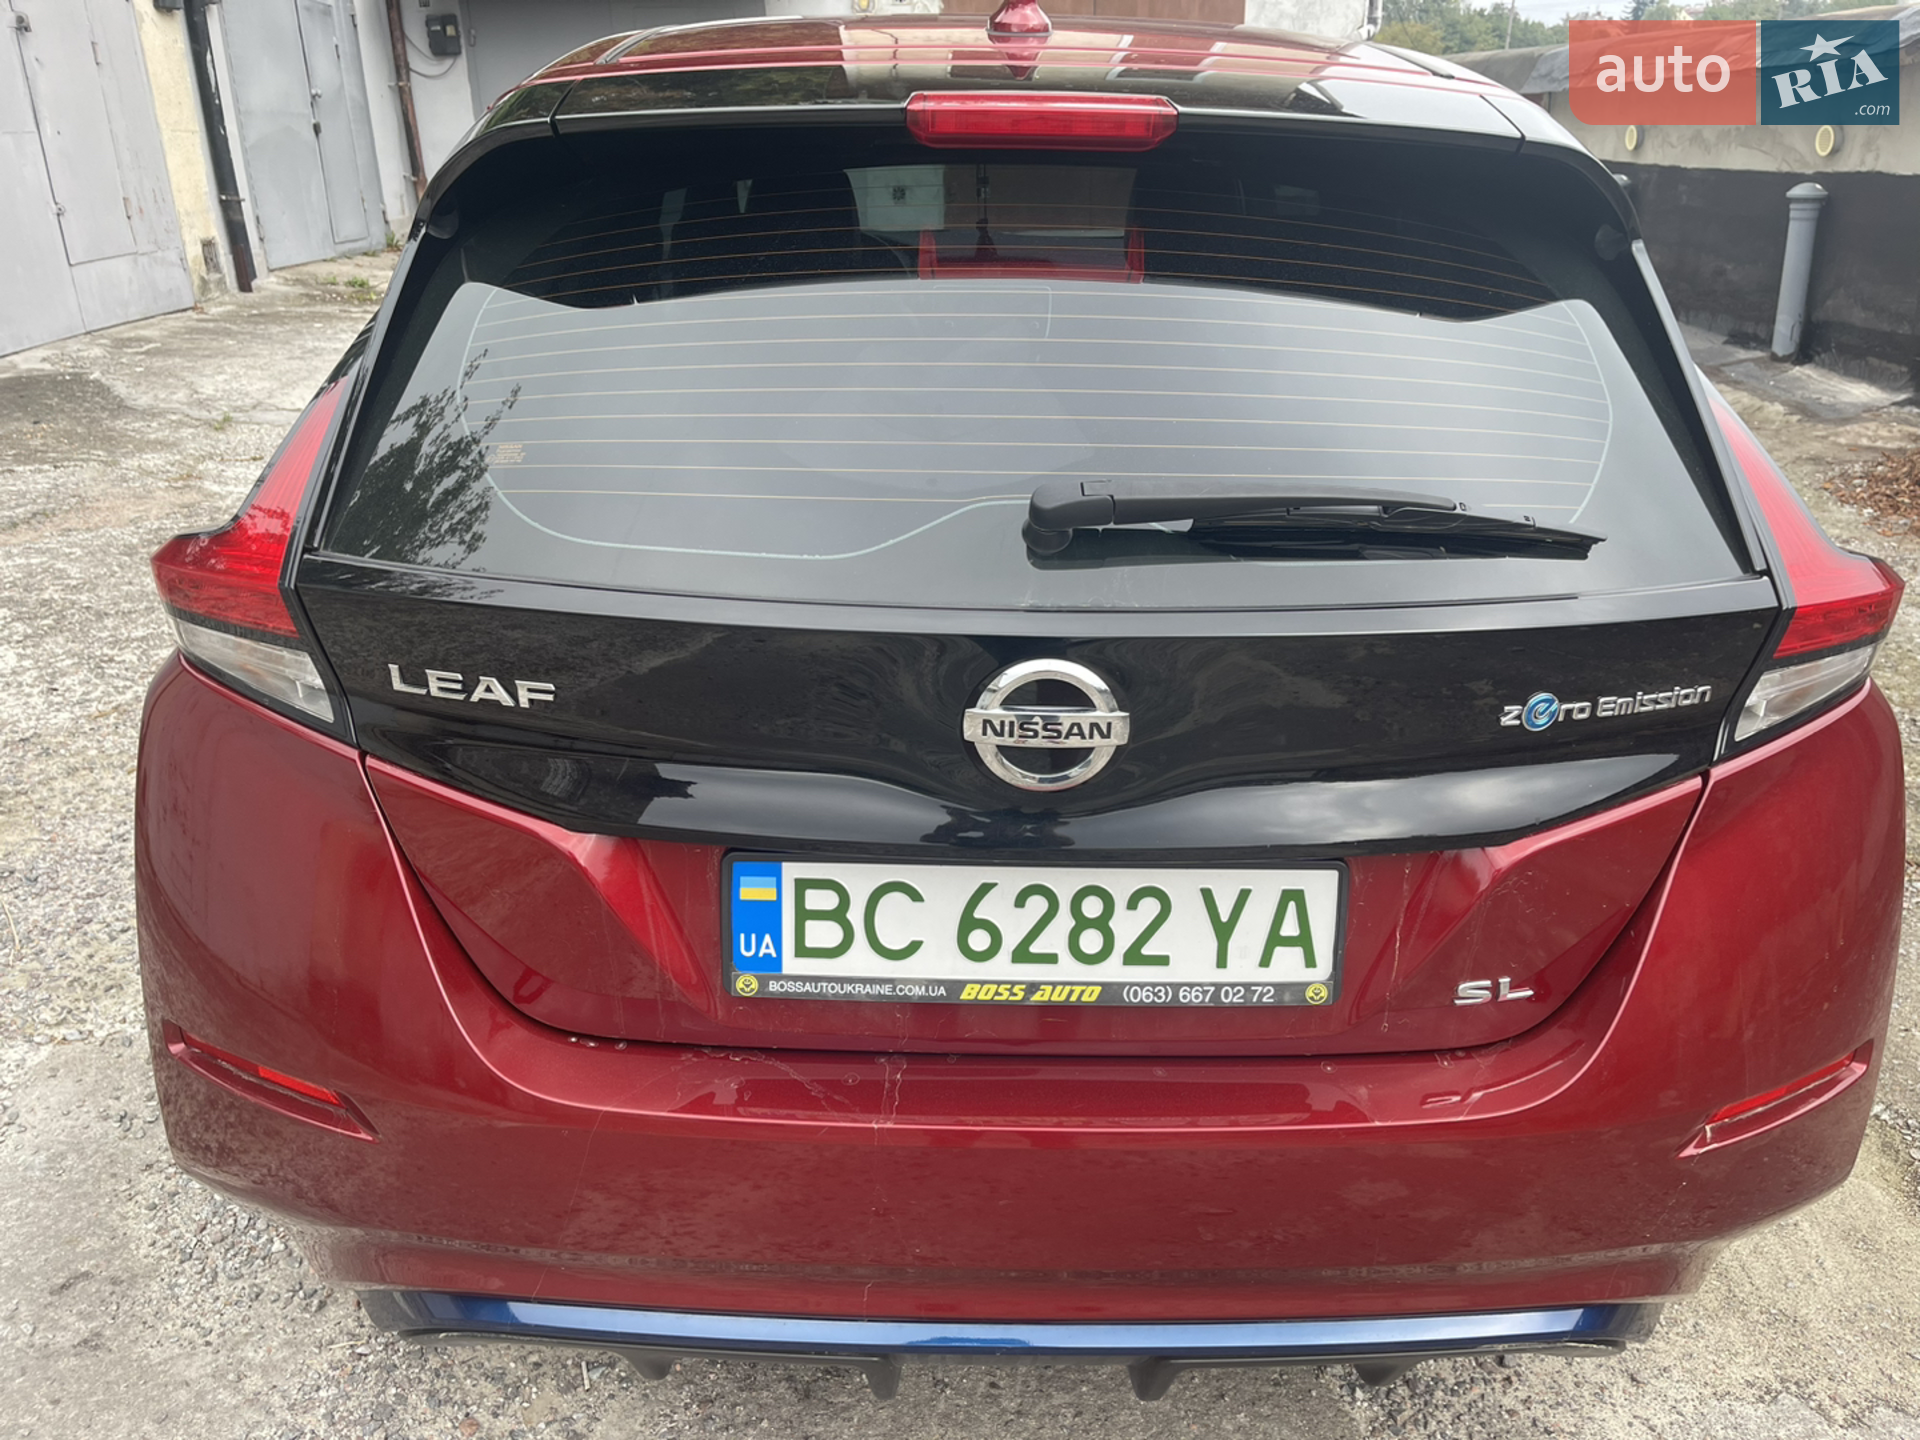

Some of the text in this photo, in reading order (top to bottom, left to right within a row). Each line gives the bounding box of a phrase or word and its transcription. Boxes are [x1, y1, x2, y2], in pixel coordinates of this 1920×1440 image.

[388, 663, 556, 708] LEAF
[1597, 685, 1712, 717] Emission
[982, 719, 1112, 740] NISSAN
[793, 877, 1317, 970] BC 6282 YA
[739, 933, 777, 958] UA
[768, 980, 1275, 1002] BOSSAUTOUKRAINE.COM.UA BOSS AUTO (063) 667 02 72
[1453, 976, 1534, 1005] SL
